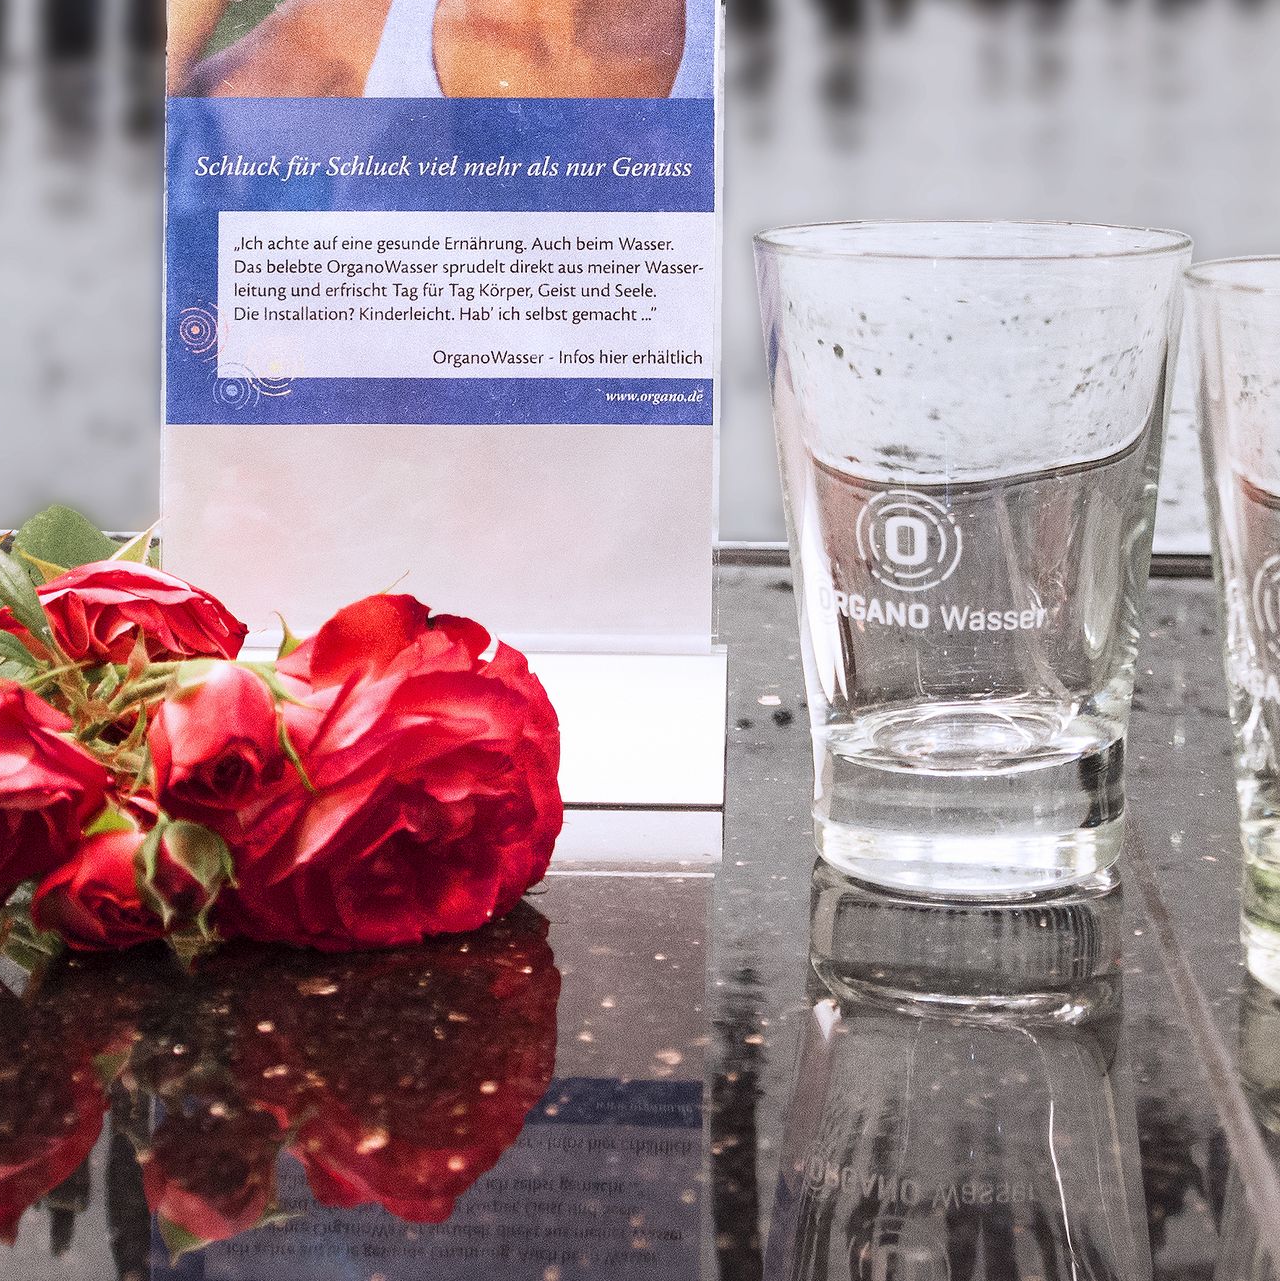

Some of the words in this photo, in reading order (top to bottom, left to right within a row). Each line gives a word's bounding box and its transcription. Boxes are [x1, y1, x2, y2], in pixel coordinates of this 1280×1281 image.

[195, 154, 281, 177] Schluck
[281, 154, 320, 182] für
[325, 154, 412, 177] Schluck
[418, 154, 458, 177] viel
[463, 155, 522, 177] mehr
[527, 155, 559, 177] als
[565, 162, 607, 177] nur
[612, 156, 693, 178] Genuss
[267, 235, 310, 251] achte
[313, 235, 338, 251] auf
[341, 236, 373, 251] eine
[376, 235, 441, 254] gesunde
[444, 236, 527, 255] Ernährung.
[531, 236, 572, 251] Auch
[576, 236, 614, 251] beim
[618, 237, 674, 252] Wasser.
[234, 259, 262, 274] Das
[266, 258, 323, 274] belebte
[326, 259, 438, 278] OrganoWasser
[442, 259, 506, 278] sprudelt
[509, 259, 554, 274] direkt
[557, 263, 584, 275] aus
[587, 259, 641, 275] meiner
[644, 260, 704, 275] Wasser-
[234, 282, 287, 302] leitung
[290, 283, 321, 298] und
[325, 281, 387, 298] erfrischt
[392, 282, 419, 302] Tag
[422, 281, 444, 298] für
[449, 282, 475, 302] Tag
[479, 283, 534, 301] Körper,
[537, 282, 577, 298] Geist
[580, 282, 611, 298] und
[614, 283, 657, 298] Seele.
[234, 306, 260, 321] Die
[264, 306, 355, 321] Installation?
[359, 306, 455, 322] Kinderleicht.
[498, 306, 521, 321] ich
[525, 306, 568, 321] selbst
[571, 306, 637, 325] gemacht
[432, 349, 544, 369] OrganoWasser
[559, 348, 595, 365] Infos
[599, 349, 628, 365] hier
[631, 349, 703, 365] erhältlich
[605, 389, 704, 405] www.organo.de
[940, 605, 1048, 631] Wasser
